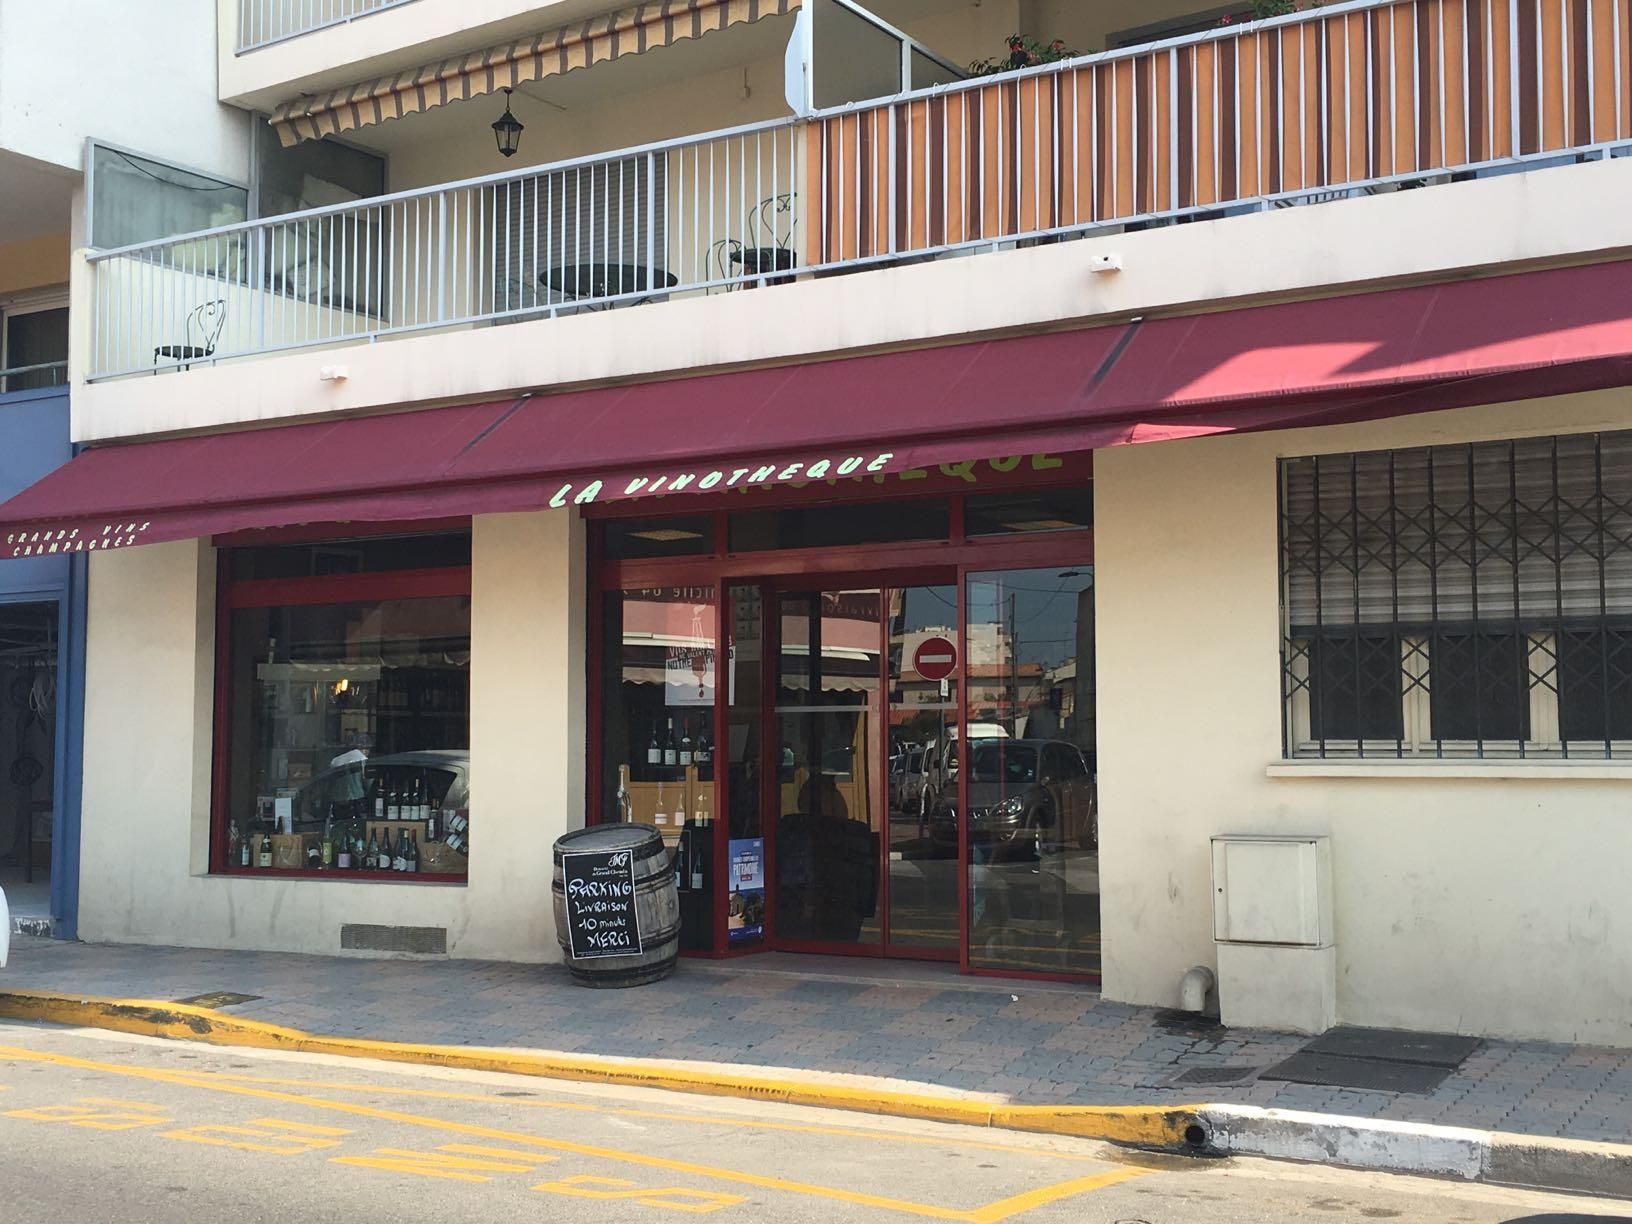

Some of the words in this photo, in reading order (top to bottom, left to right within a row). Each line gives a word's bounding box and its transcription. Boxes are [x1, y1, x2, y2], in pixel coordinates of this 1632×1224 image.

[549, 480, 603, 508] LA
[624, 453, 894, 494] VINOTHEQUE
[7, 529, 79, 544] GRANDS
[102, 521, 150, 535] VINS
[13, 535, 136, 557] CHAMPAGNES
[578, 918, 597, 930] 10
